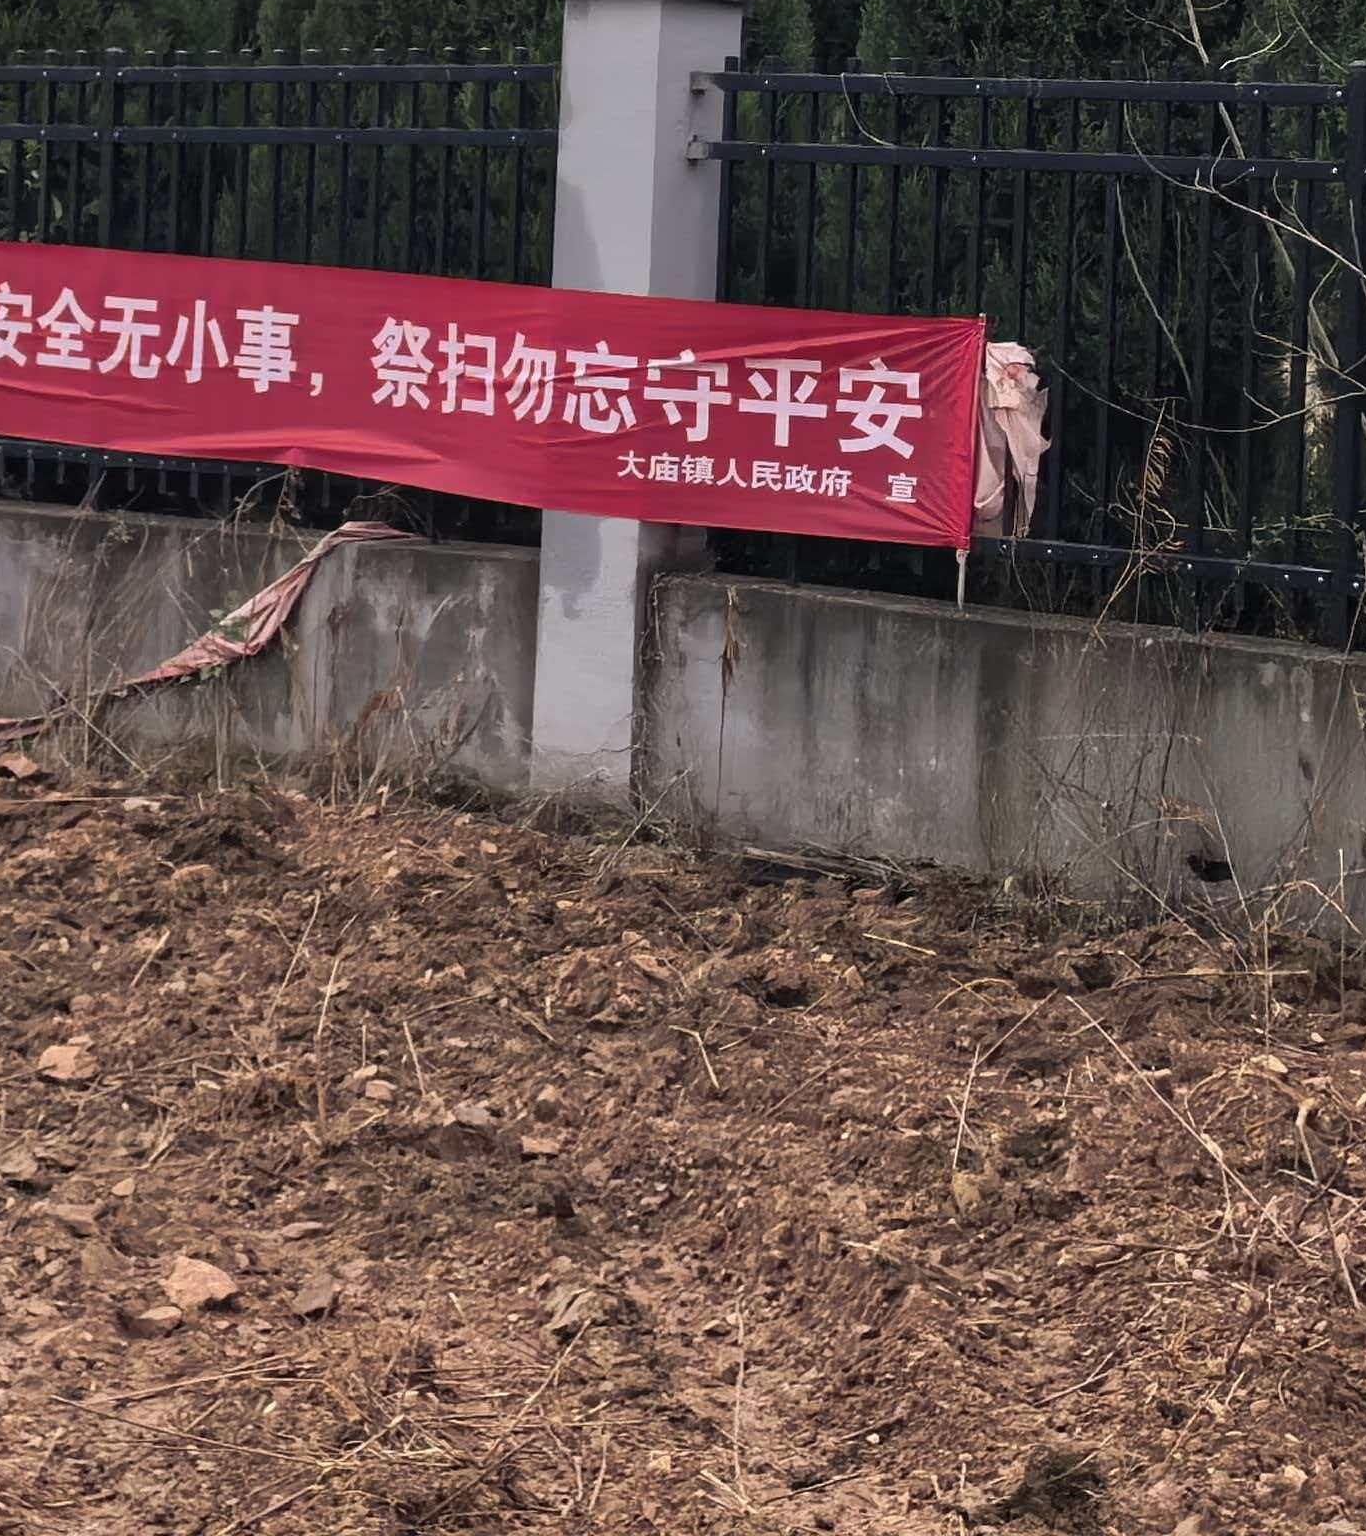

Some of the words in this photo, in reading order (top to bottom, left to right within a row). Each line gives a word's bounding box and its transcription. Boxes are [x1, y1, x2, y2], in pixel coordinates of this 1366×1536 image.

[371, 317, 923, 459] 祭扫勿忘守平安
[617, 451, 852, 497] 大庙镇人民政府
[885, 473, 918, 504] 宣
